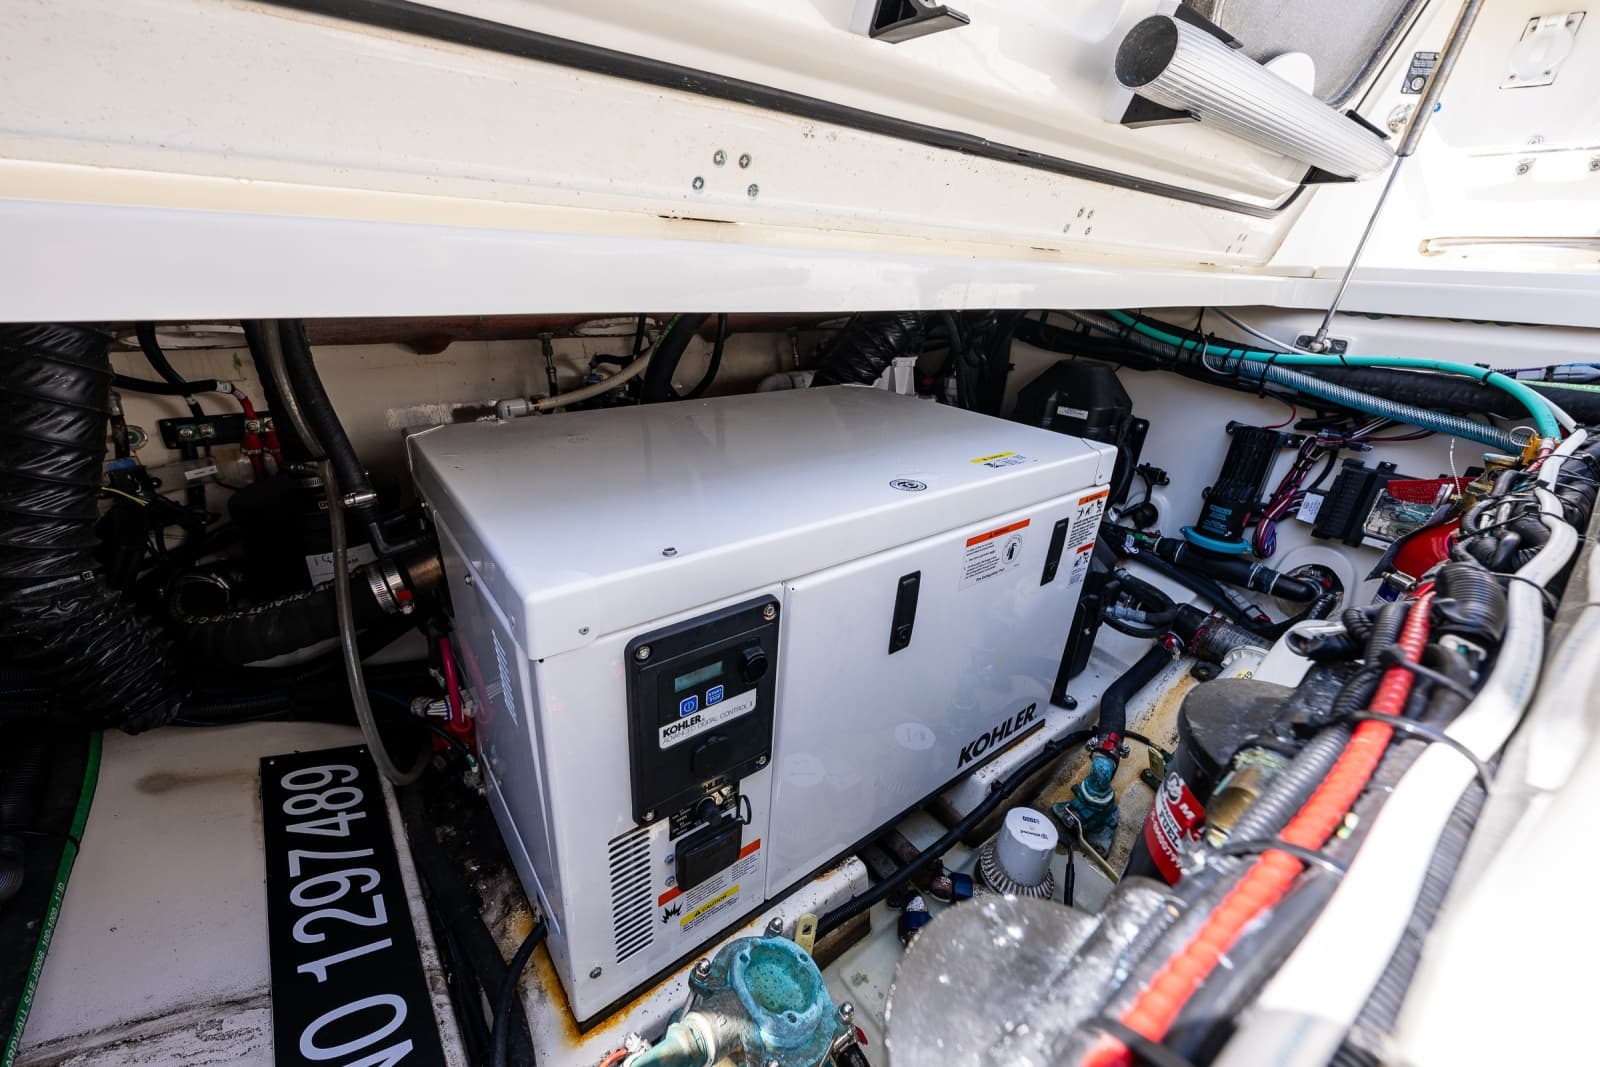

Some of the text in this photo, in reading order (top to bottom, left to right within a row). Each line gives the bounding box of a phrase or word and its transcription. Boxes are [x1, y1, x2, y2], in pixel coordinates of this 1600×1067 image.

[662, 714, 702, 738] KOHLER
[957, 702, 1037, 769] KOHLER
[281, 764, 393, 983] 1297489
[702, 895, 727, 912] CAUTION
[24, 981, 36, 1007] SAE
